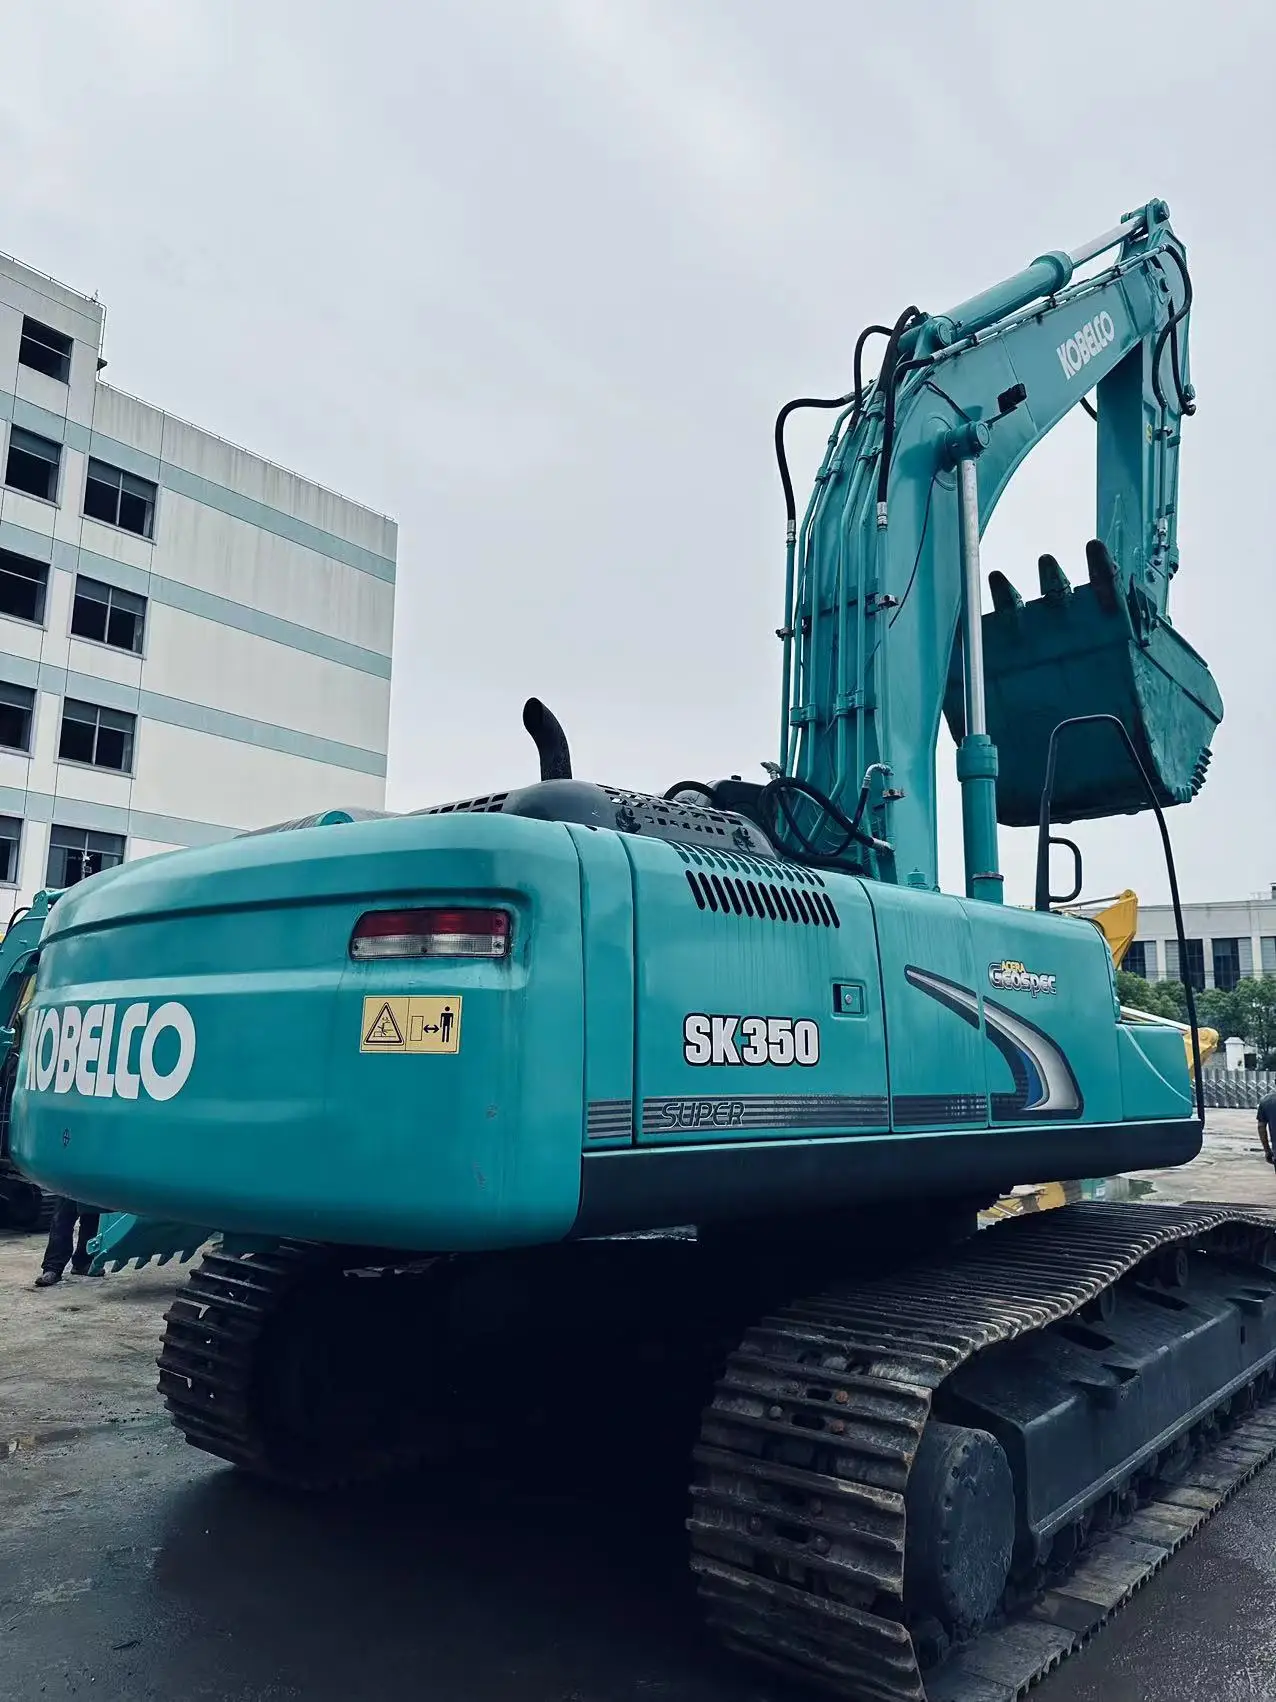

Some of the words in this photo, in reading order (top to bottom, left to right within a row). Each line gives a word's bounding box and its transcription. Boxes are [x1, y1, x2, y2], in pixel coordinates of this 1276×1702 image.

[1057, 311, 1115, 380] KOBELCO
[25, 1002, 196, 1101] KOBELCO
[684, 1014, 820, 1067] SK350
[660, 1101, 745, 1129] SUPER
